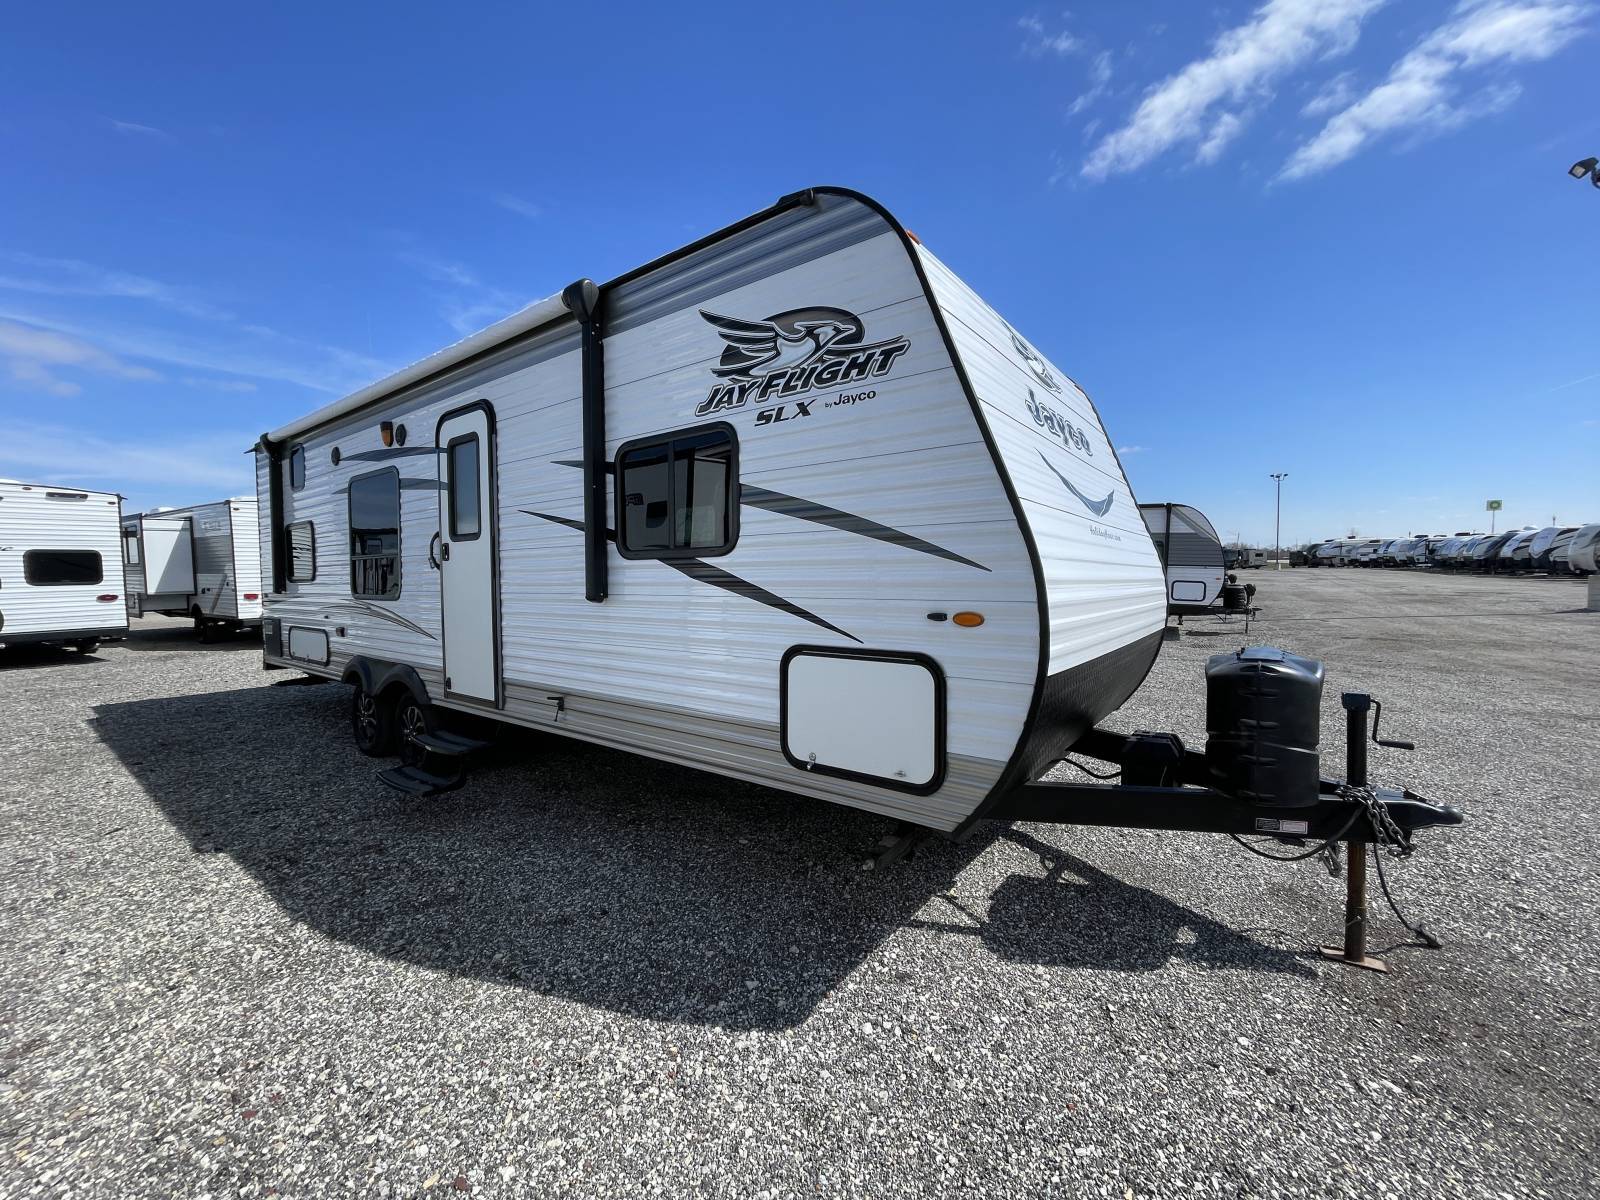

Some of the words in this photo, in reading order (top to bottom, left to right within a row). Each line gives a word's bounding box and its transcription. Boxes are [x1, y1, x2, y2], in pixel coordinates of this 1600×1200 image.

[754, 399, 817, 427] SLX
[824, 401, 833, 409] by
[833, 390, 877, 407] Jayco
[1025, 387, 1093, 456] Jayco
